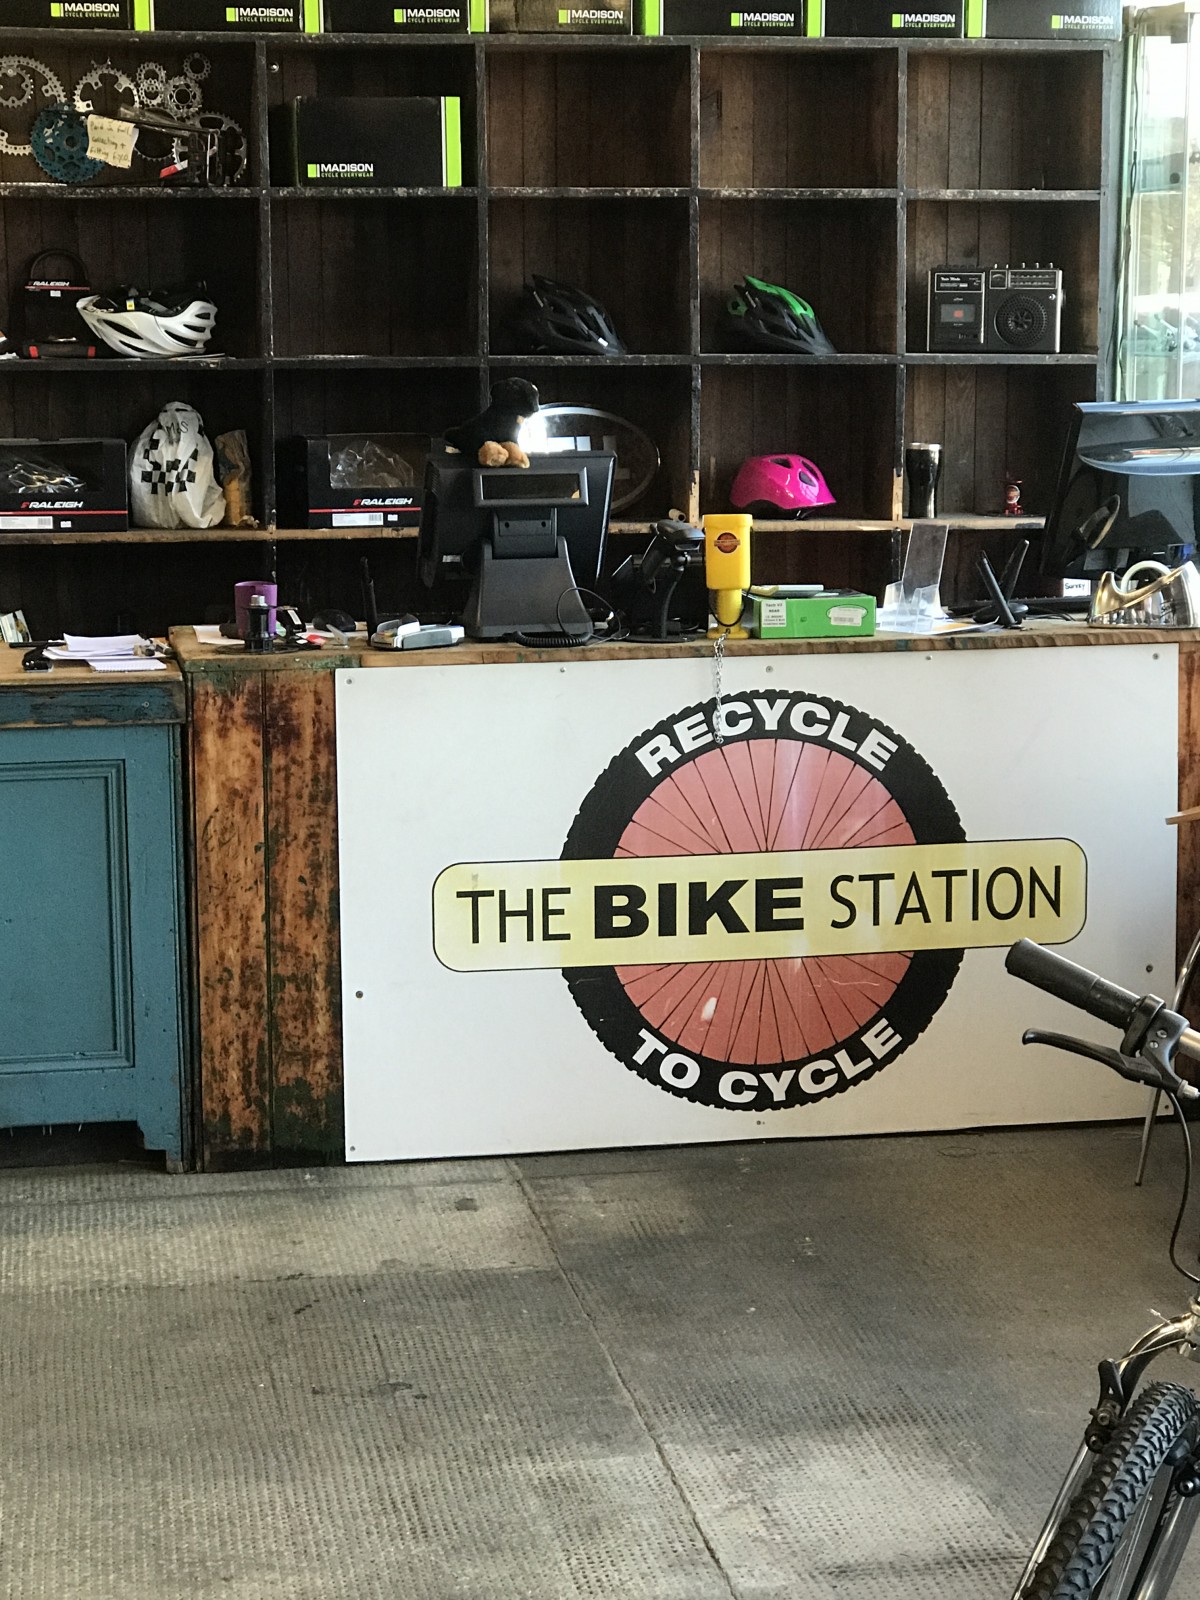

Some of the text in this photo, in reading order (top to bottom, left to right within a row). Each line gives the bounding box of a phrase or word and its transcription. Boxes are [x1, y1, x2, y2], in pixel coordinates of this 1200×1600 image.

[65, 3, 120, 12] MADISON
[240, 8, 294, 17] MADISON
[407, 9, 460, 18] MADISON
[572, 10, 624, 19] MADISON
[743, 12, 795, 22] MADISON
[905, 14, 956, 23] MADISON
[1064, 15, 1114, 25] MADISON
[321, 163, 374, 172] MADISON
[28, 501, 84, 509] RALEIGH
[361, 497, 413, 506] RALEIGH
[635, 698, 899, 778] RECYCLE
[456, 865, 1063, 945] THE BIKE STATION
[633, 1018, 902, 1104] TO CYCLE
